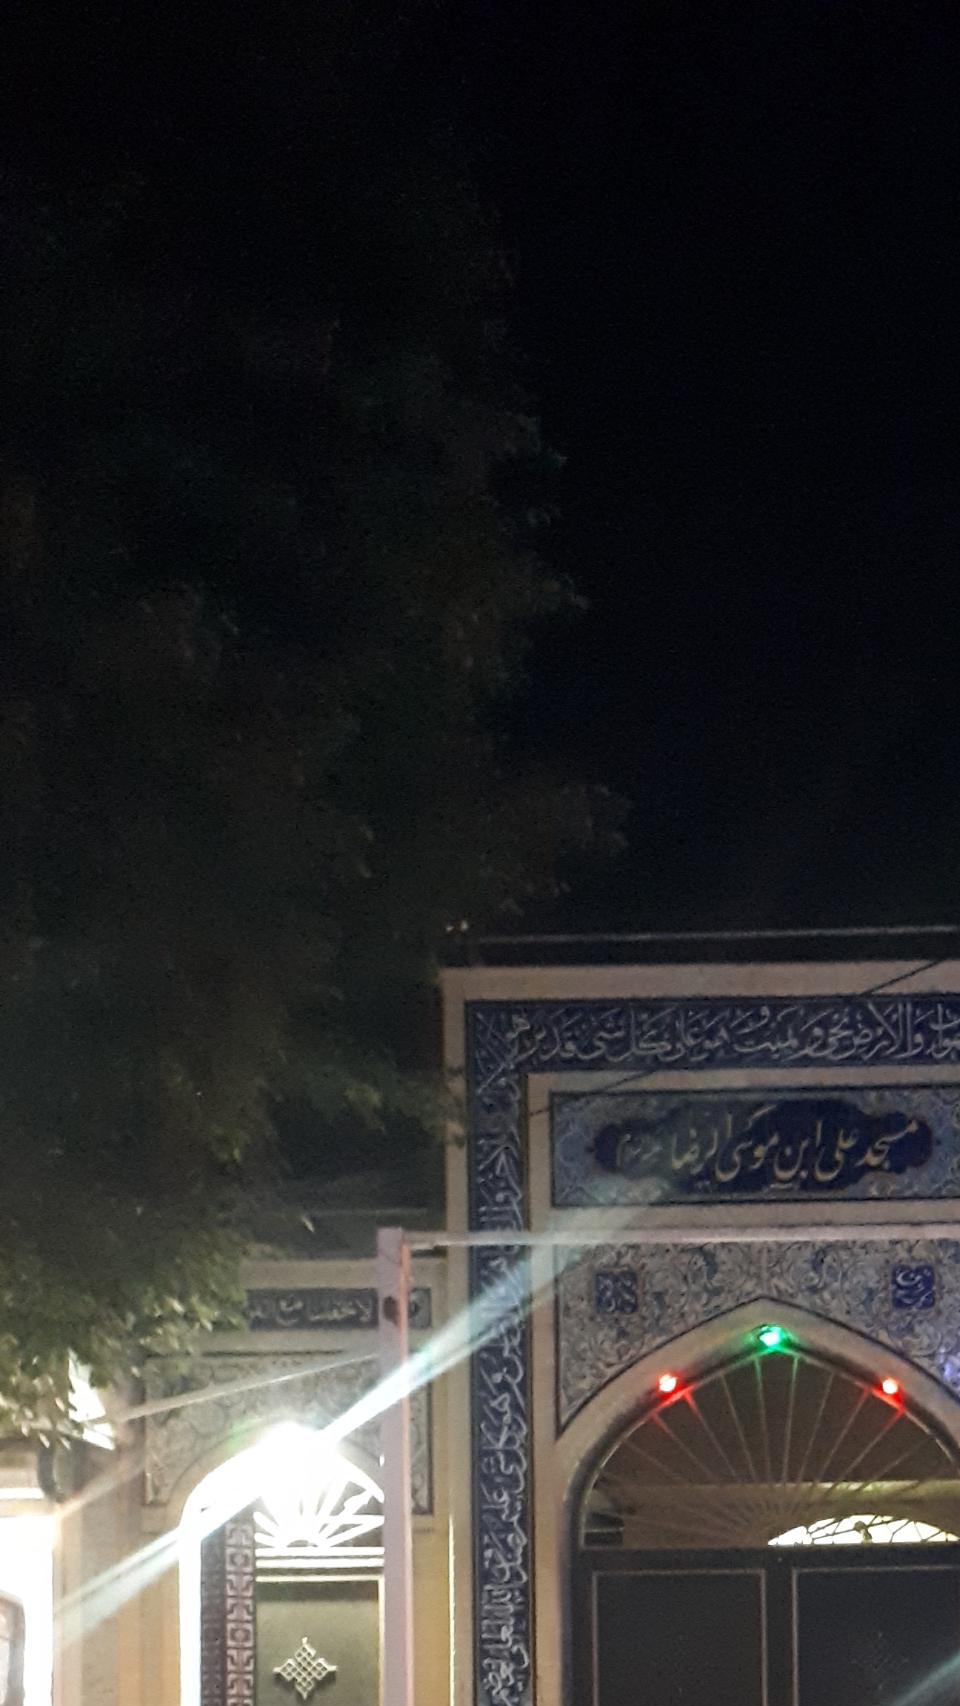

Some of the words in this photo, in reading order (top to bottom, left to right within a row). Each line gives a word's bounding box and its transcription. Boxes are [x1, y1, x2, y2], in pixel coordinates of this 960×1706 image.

[671, 1113, 735, 1176] الرضا
[714, 1132, 780, 1182] موسی
[773, 1119, 823, 1182] ابن
[814, 1126, 859, 1182] علی
[856, 1119, 918, 1170] مسجد
